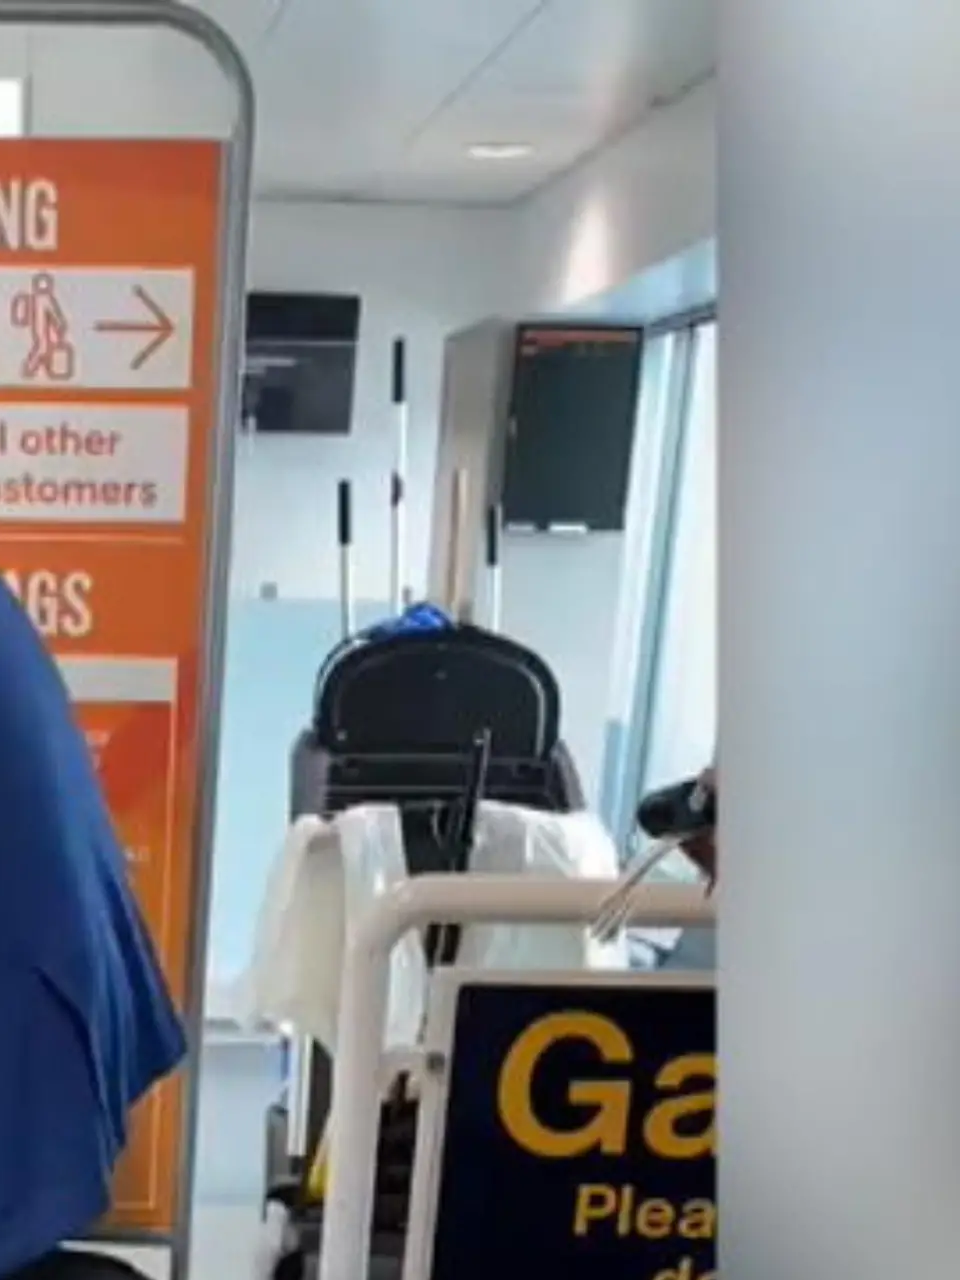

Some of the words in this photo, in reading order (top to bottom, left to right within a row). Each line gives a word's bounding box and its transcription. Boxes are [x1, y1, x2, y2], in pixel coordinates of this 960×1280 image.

[19, 421, 122, 458] other
[497, 1009, 717, 1158] Ga
[573, 1182, 716, 1240] Plea
